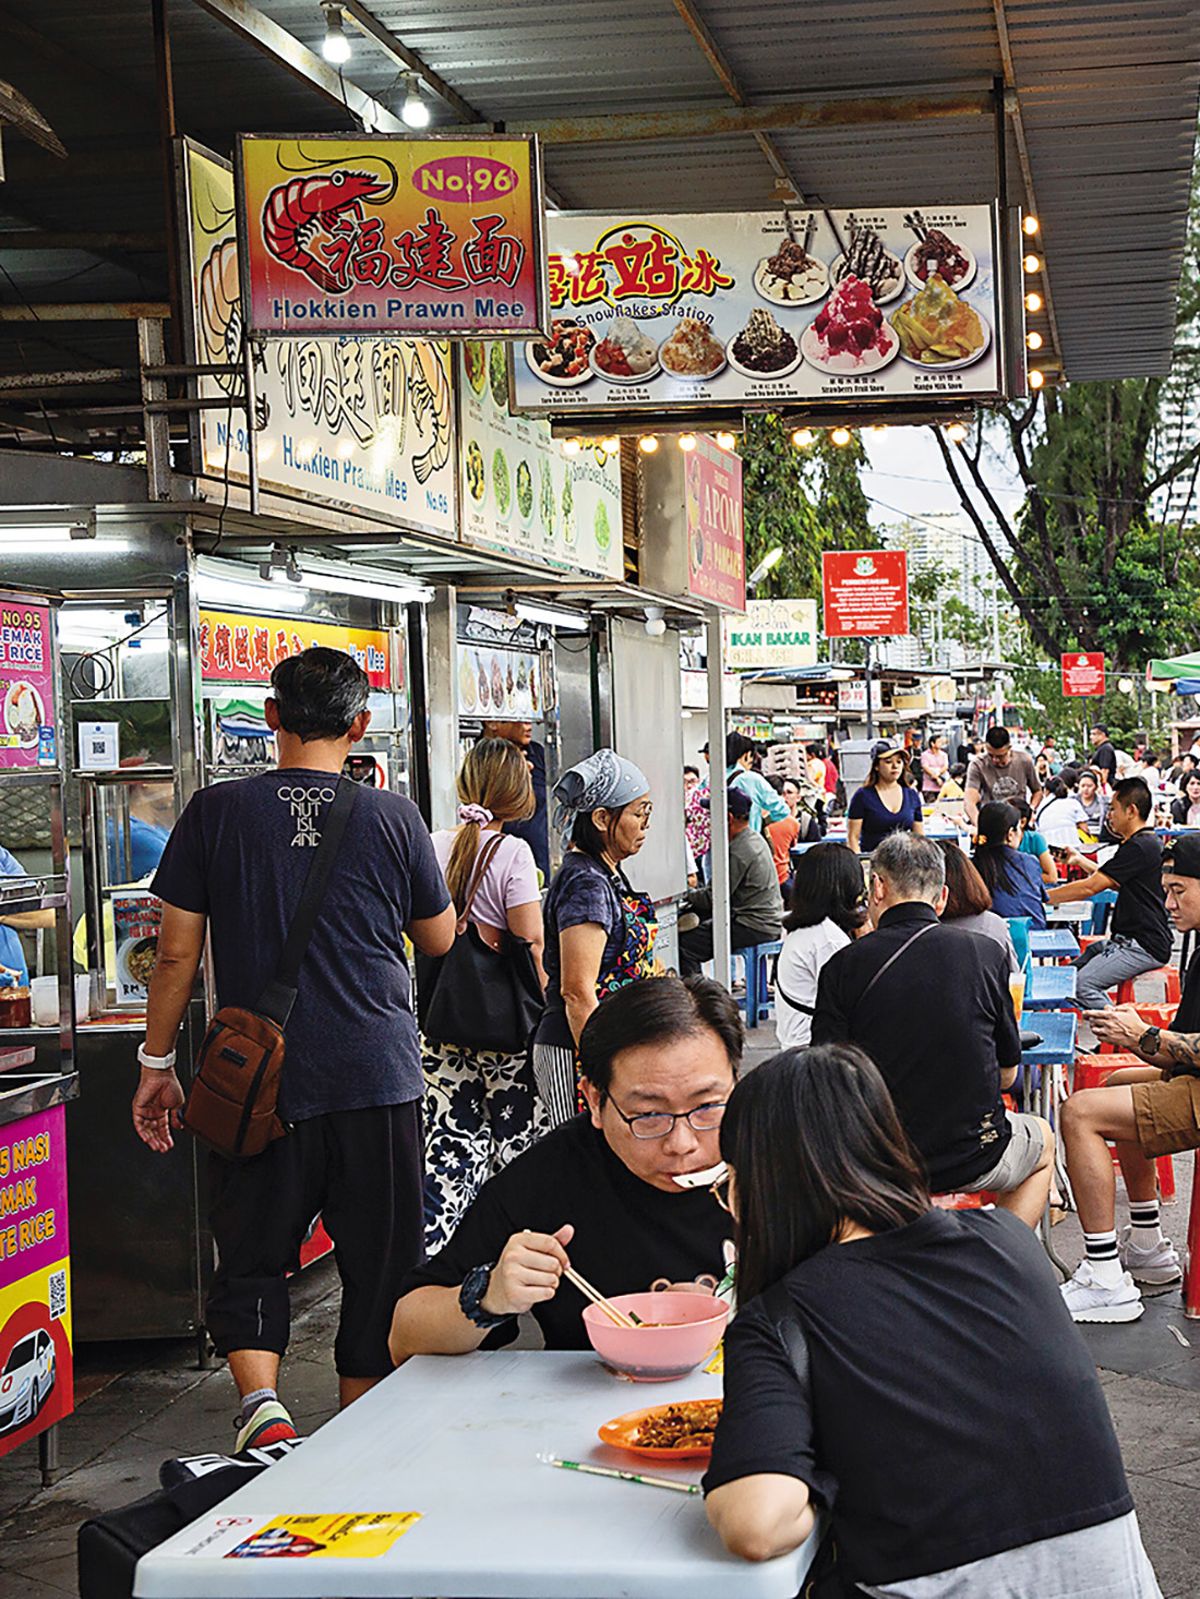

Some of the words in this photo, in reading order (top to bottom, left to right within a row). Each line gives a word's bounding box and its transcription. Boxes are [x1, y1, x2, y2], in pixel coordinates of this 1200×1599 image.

[420, 167, 513, 194] No.96
[322, 206, 524, 292] 福建面
[273, 299, 378, 320] Hokkien
[386, 299, 466, 320] Prawn
[473, 299, 525, 319] Mee
[575, 303, 658, 329] Snowflakes
[661, 303, 716, 326] Station
[703, 482, 742, 542] APOM
[2, 611, 42, 630] NO.95
[730, 631, 763, 647] IKAN
[766, 631, 811, 646] BAKAR
[10, 646, 43, 662] RICE
[367, 645, 386, 673] Mee
[276, 786, 336, 803] COCO
[290, 801, 322, 818] NUT
[296, 816, 317, 832] ISL
[290, 831, 322, 848] AND
[12, 1131, 51, 1174] NASI
[19, 1207, 56, 1252] RICE
